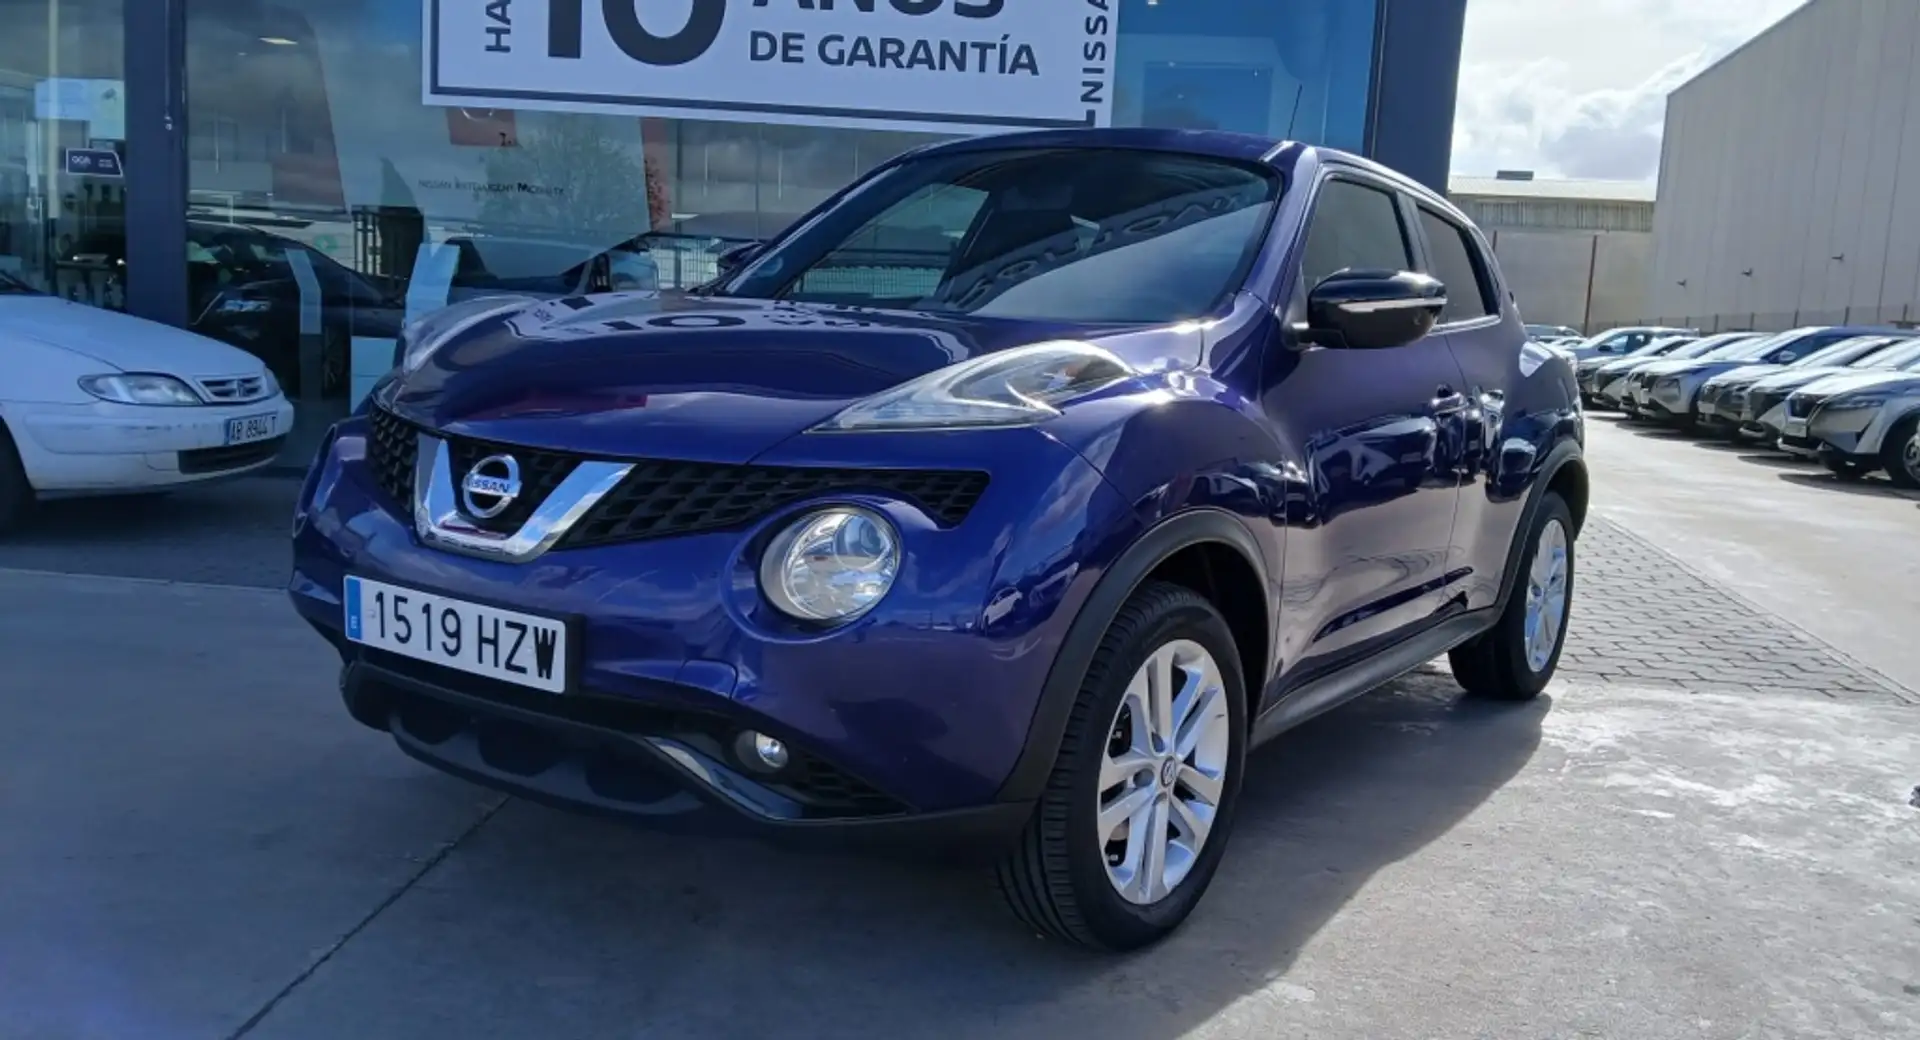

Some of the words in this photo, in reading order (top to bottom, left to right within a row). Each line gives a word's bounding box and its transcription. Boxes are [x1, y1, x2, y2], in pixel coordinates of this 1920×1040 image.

[750, 30, 805, 63] DE
[817, 34, 1039, 76] GARANTÍA
[375, 590, 462, 658] 1519
[477, 614, 557, 680] HZW
